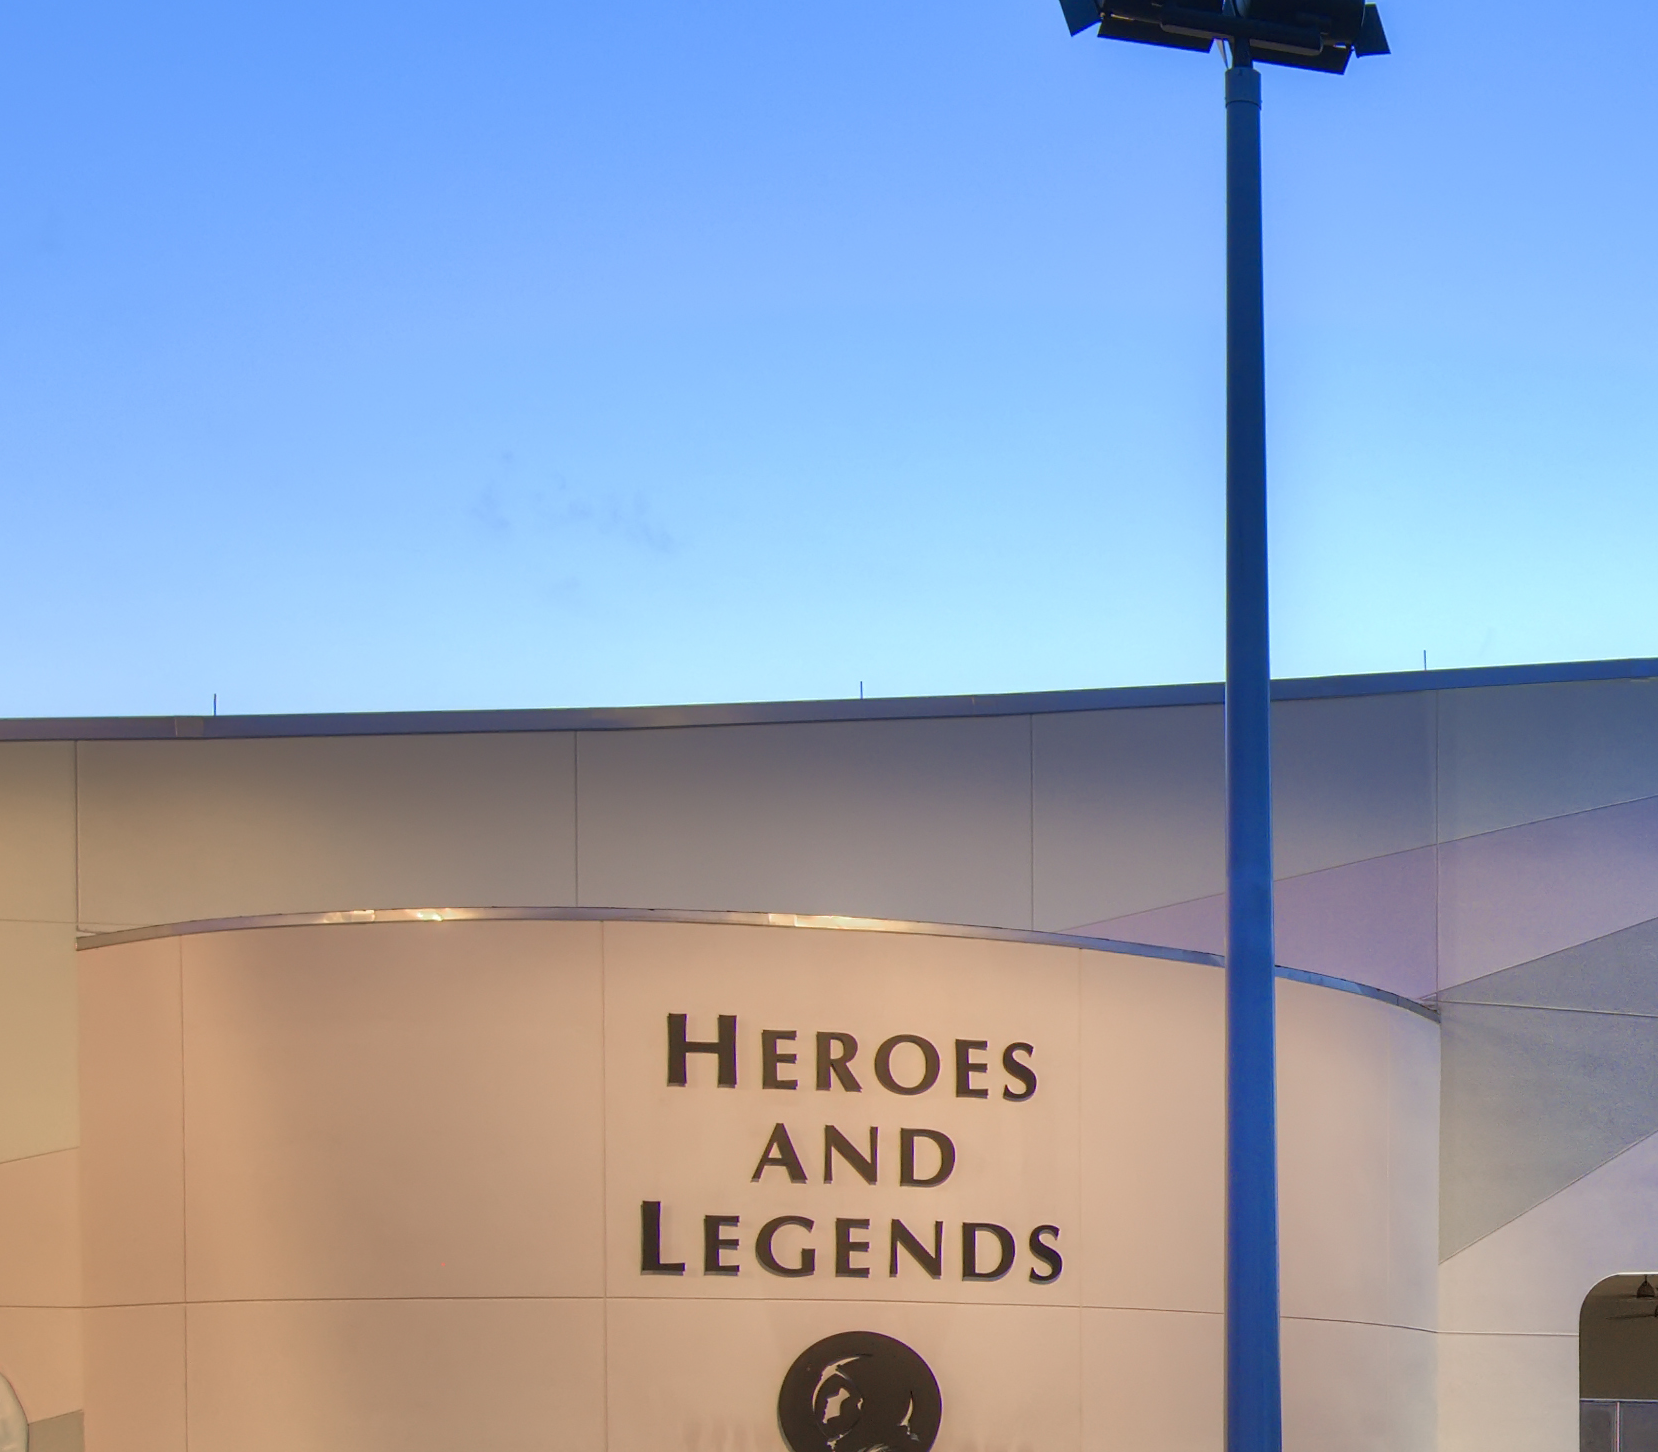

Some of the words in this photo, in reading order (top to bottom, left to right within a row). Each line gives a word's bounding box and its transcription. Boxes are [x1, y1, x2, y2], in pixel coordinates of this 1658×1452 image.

[665, 1012, 1039, 1101] HEROES
[751, 1122, 958, 1188] AND
[639, 1200, 1064, 1285] LEGENDS
